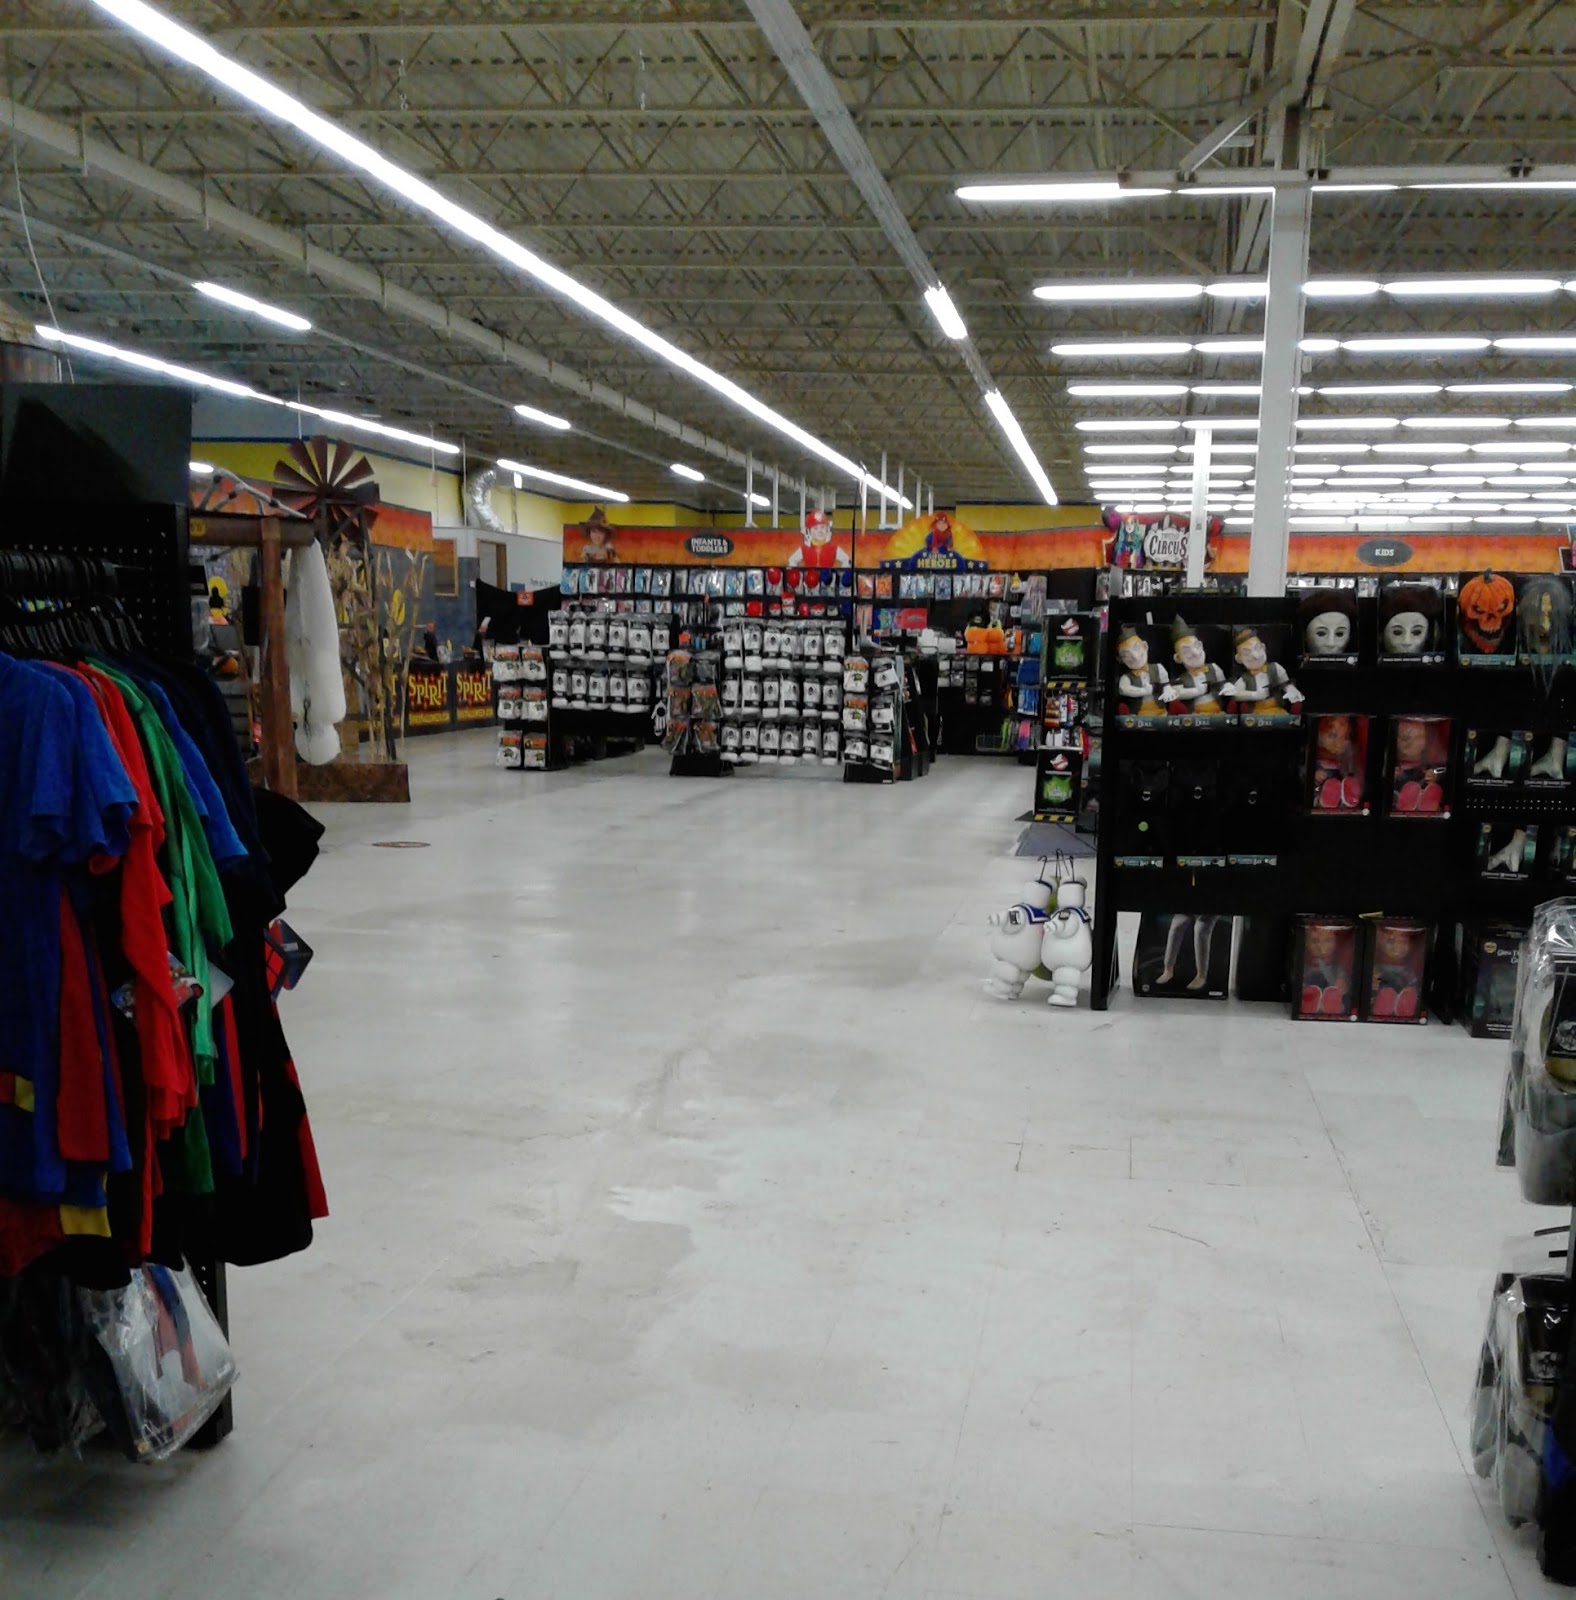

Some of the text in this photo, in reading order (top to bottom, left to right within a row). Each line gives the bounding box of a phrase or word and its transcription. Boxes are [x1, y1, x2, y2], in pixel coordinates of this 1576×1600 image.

[691, 537, 721, 546] INFANTS
[1149, 535, 1188, 558] CIRCUS
[692, 545, 728, 554] TODDLERS
[1375, 548, 1395, 557] KIDS
[917, 558, 957, 569] HEROES
[408, 672, 448, 706] SPIRIT
[456, 669, 492, 702] SPIRIT
